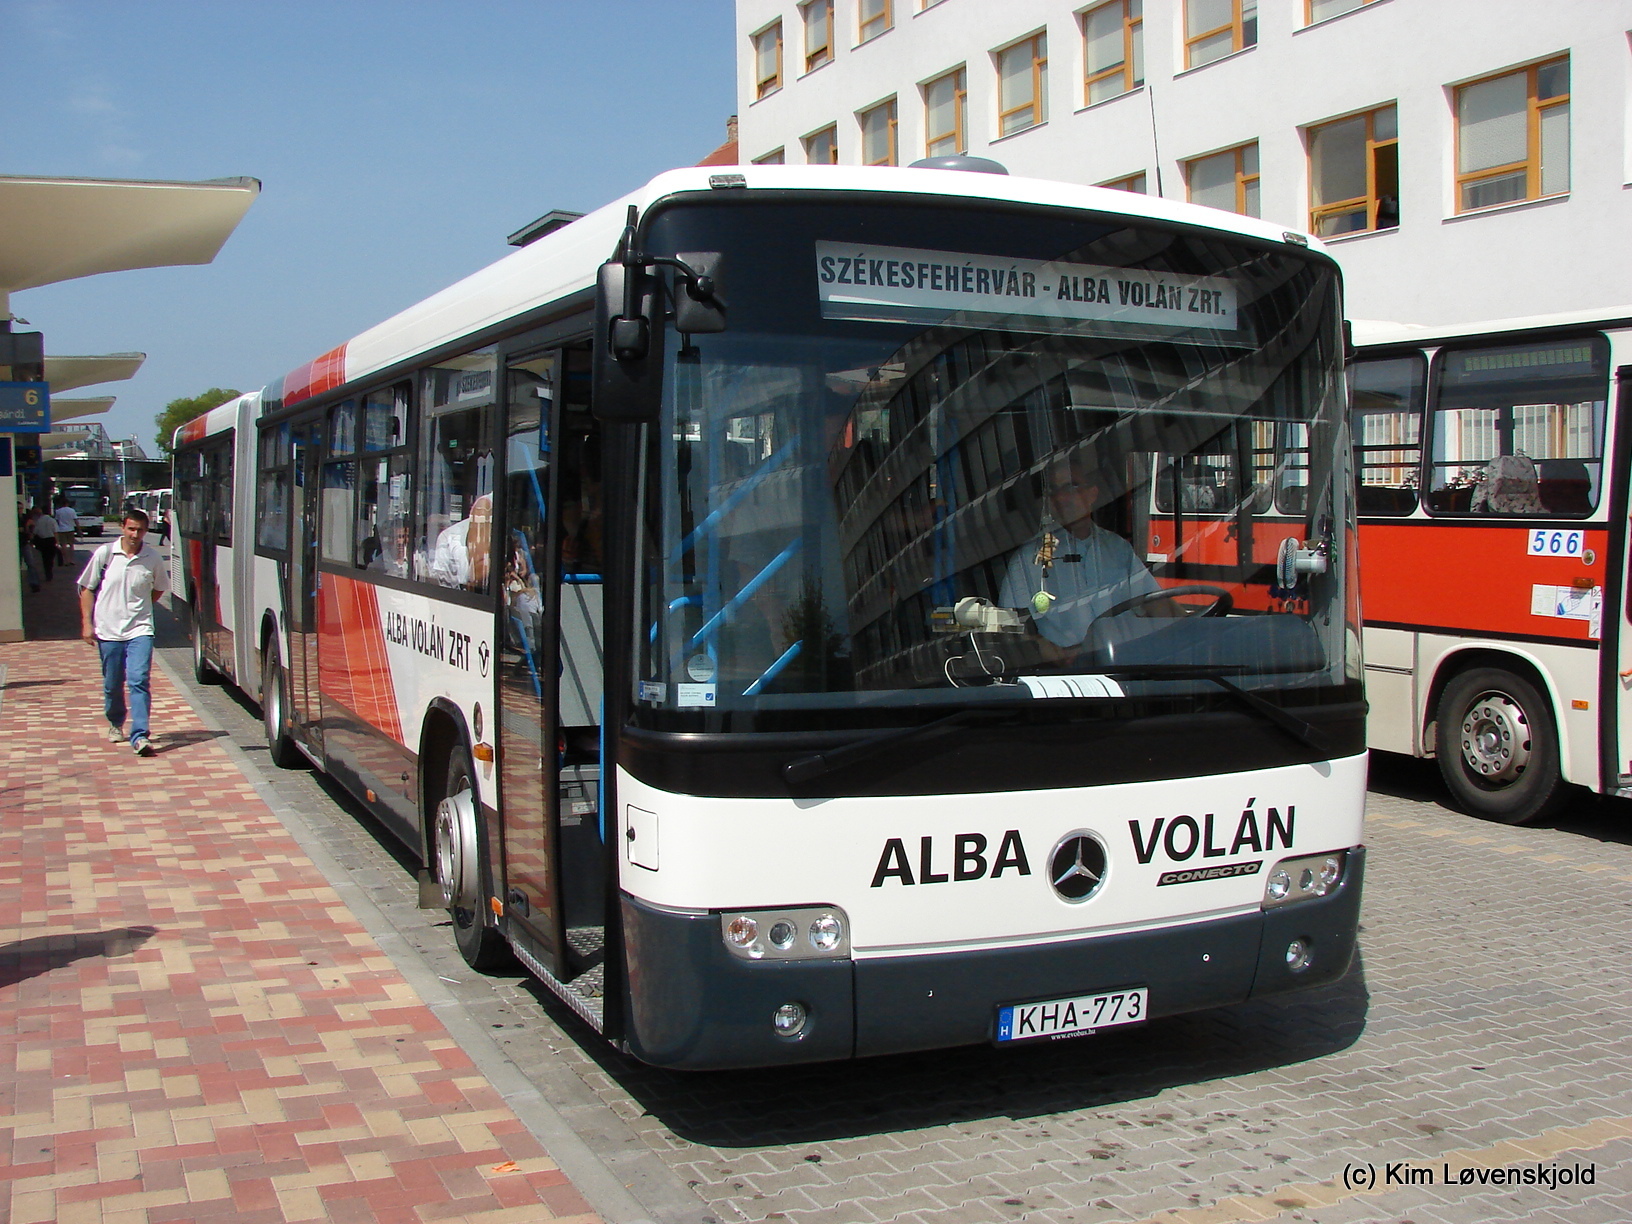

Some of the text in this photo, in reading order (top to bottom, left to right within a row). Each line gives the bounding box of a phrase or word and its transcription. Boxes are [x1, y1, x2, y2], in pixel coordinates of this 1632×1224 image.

[820, 248, 1036, 298] SZÉKESFEHÉRVÁR
[1057, 275, 1111, 304] ALBA
[1117, 279, 1182, 311] VOLÁN
[1187, 287, 1226, 316] ZRT.
[25, 389, 39, 405] 6
[1533, 531, 1579, 554] 566
[386, 611, 471, 672] ALBA VOLÁN ZRT
[870, 797, 1296, 888] ALBA VOLÁN
[1161, 863, 1260, 885] CONECTO
[1000, 991, 1142, 1037] H KHA-773
[1050, 1027, 1097, 1041] www.evobus.hu
